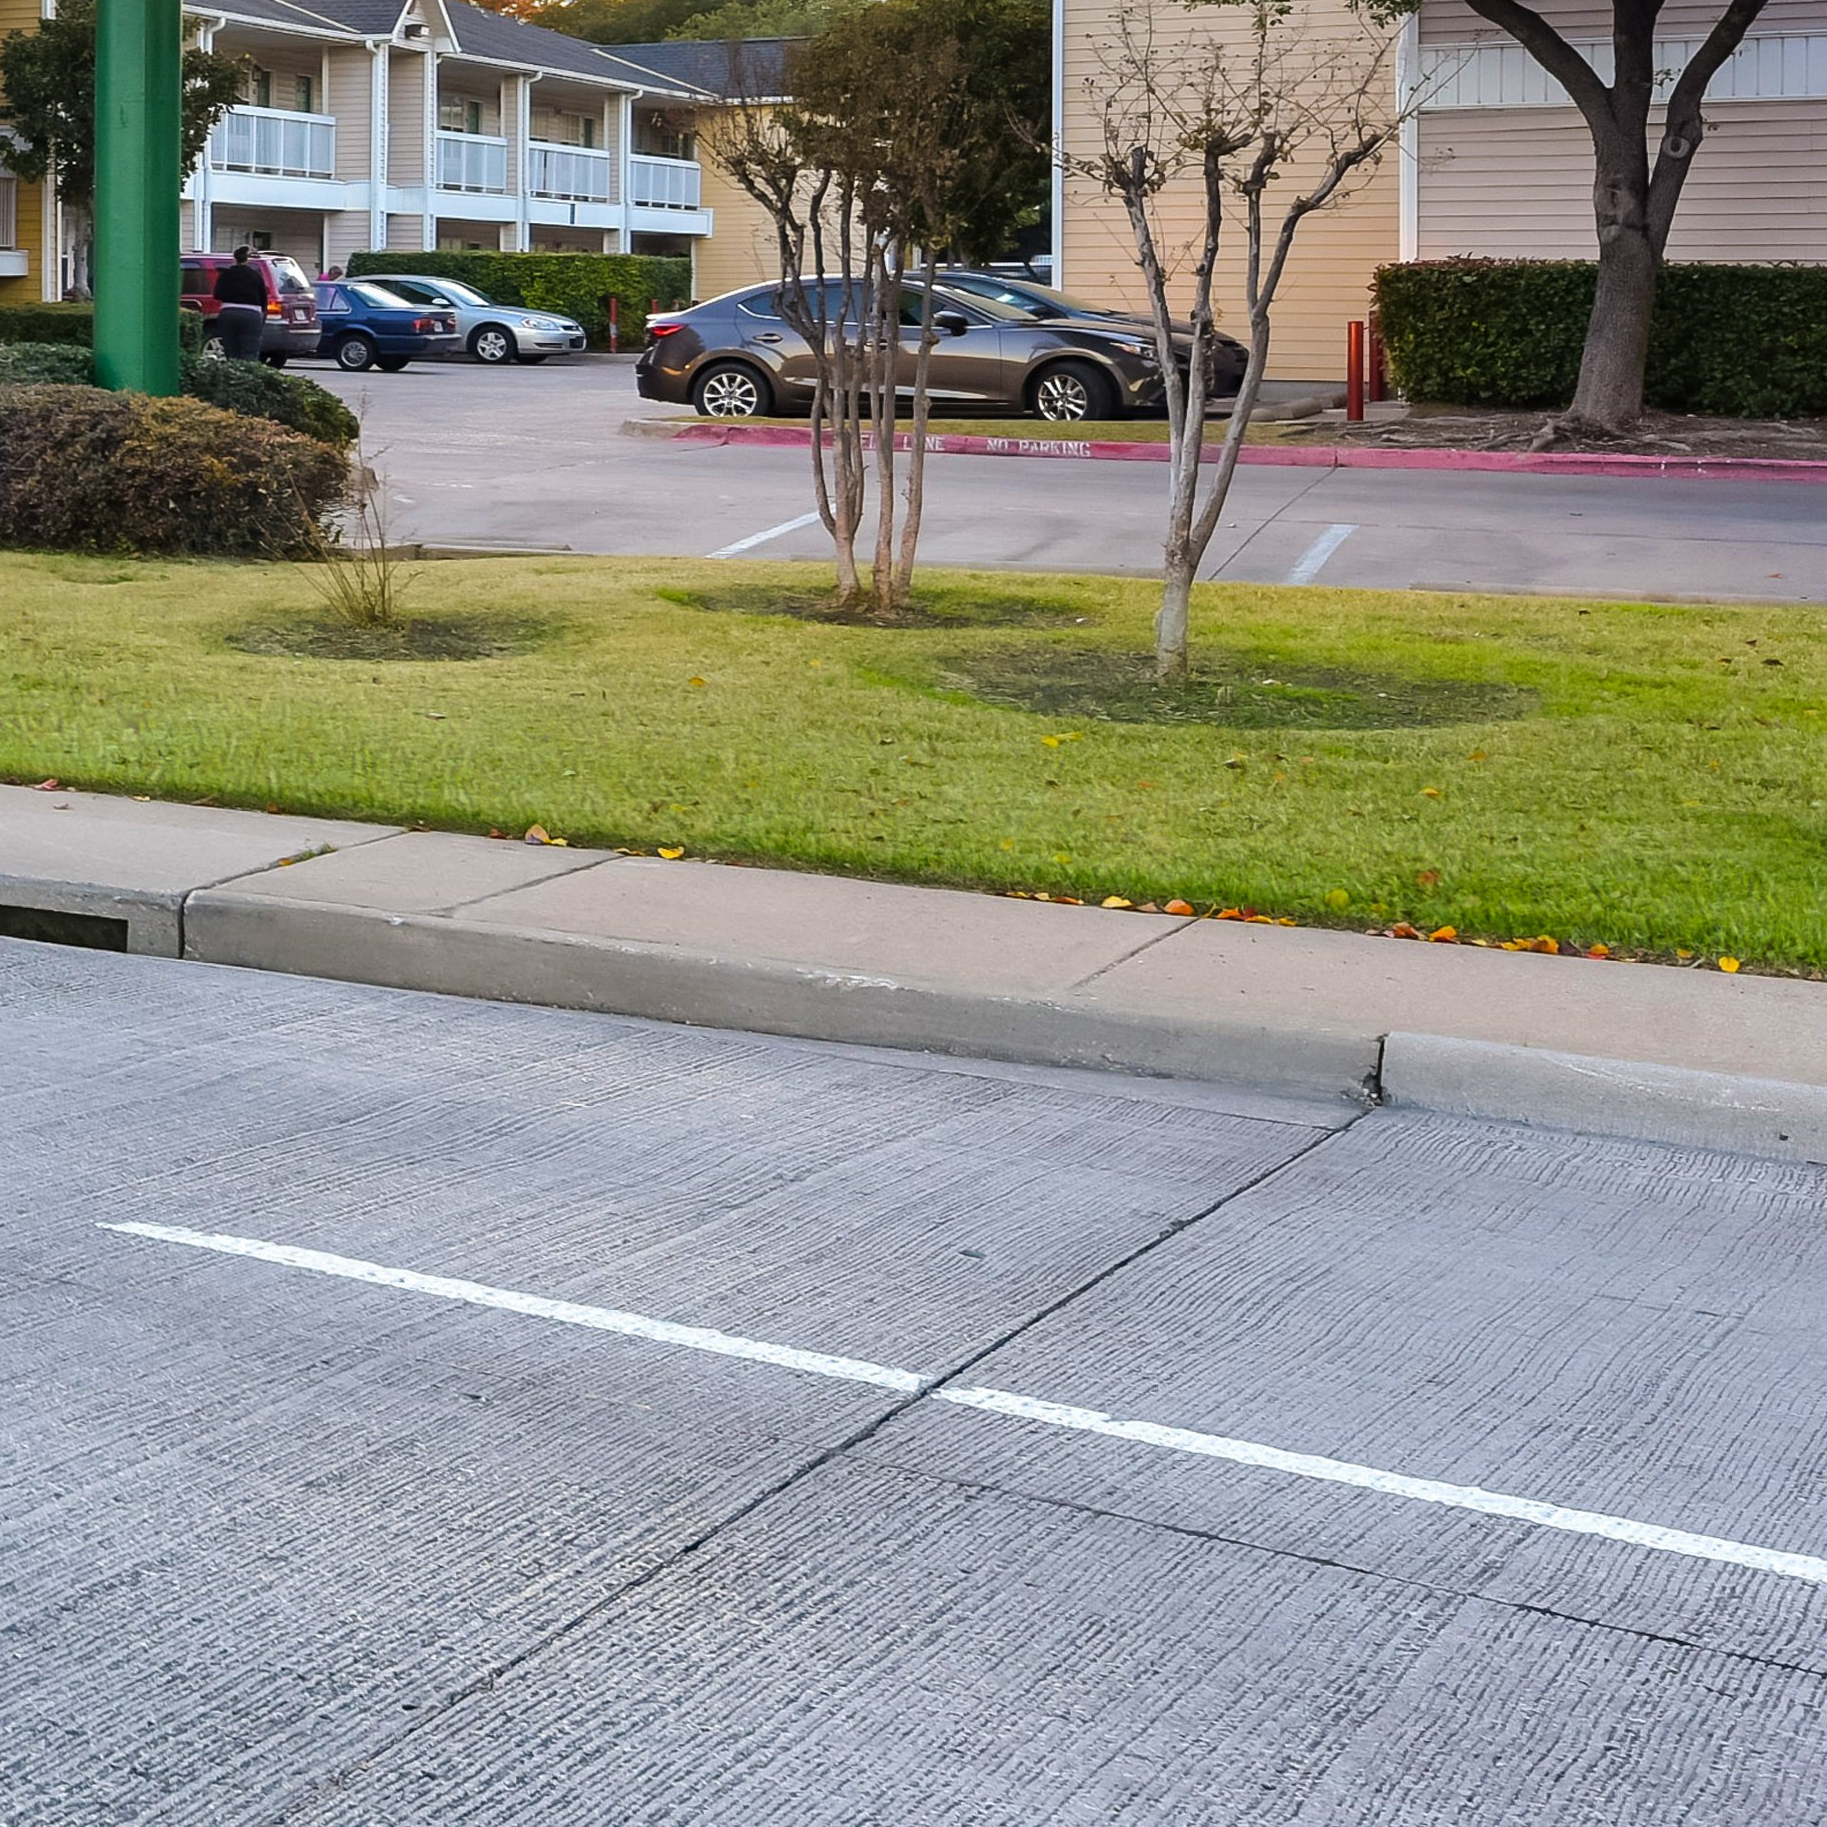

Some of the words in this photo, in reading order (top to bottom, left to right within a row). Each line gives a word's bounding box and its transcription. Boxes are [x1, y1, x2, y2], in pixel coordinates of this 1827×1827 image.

[902, 435, 946, 451] LNE
[986, 438, 1009, 452] NO
[1019, 439, 1091, 457] PARKING
